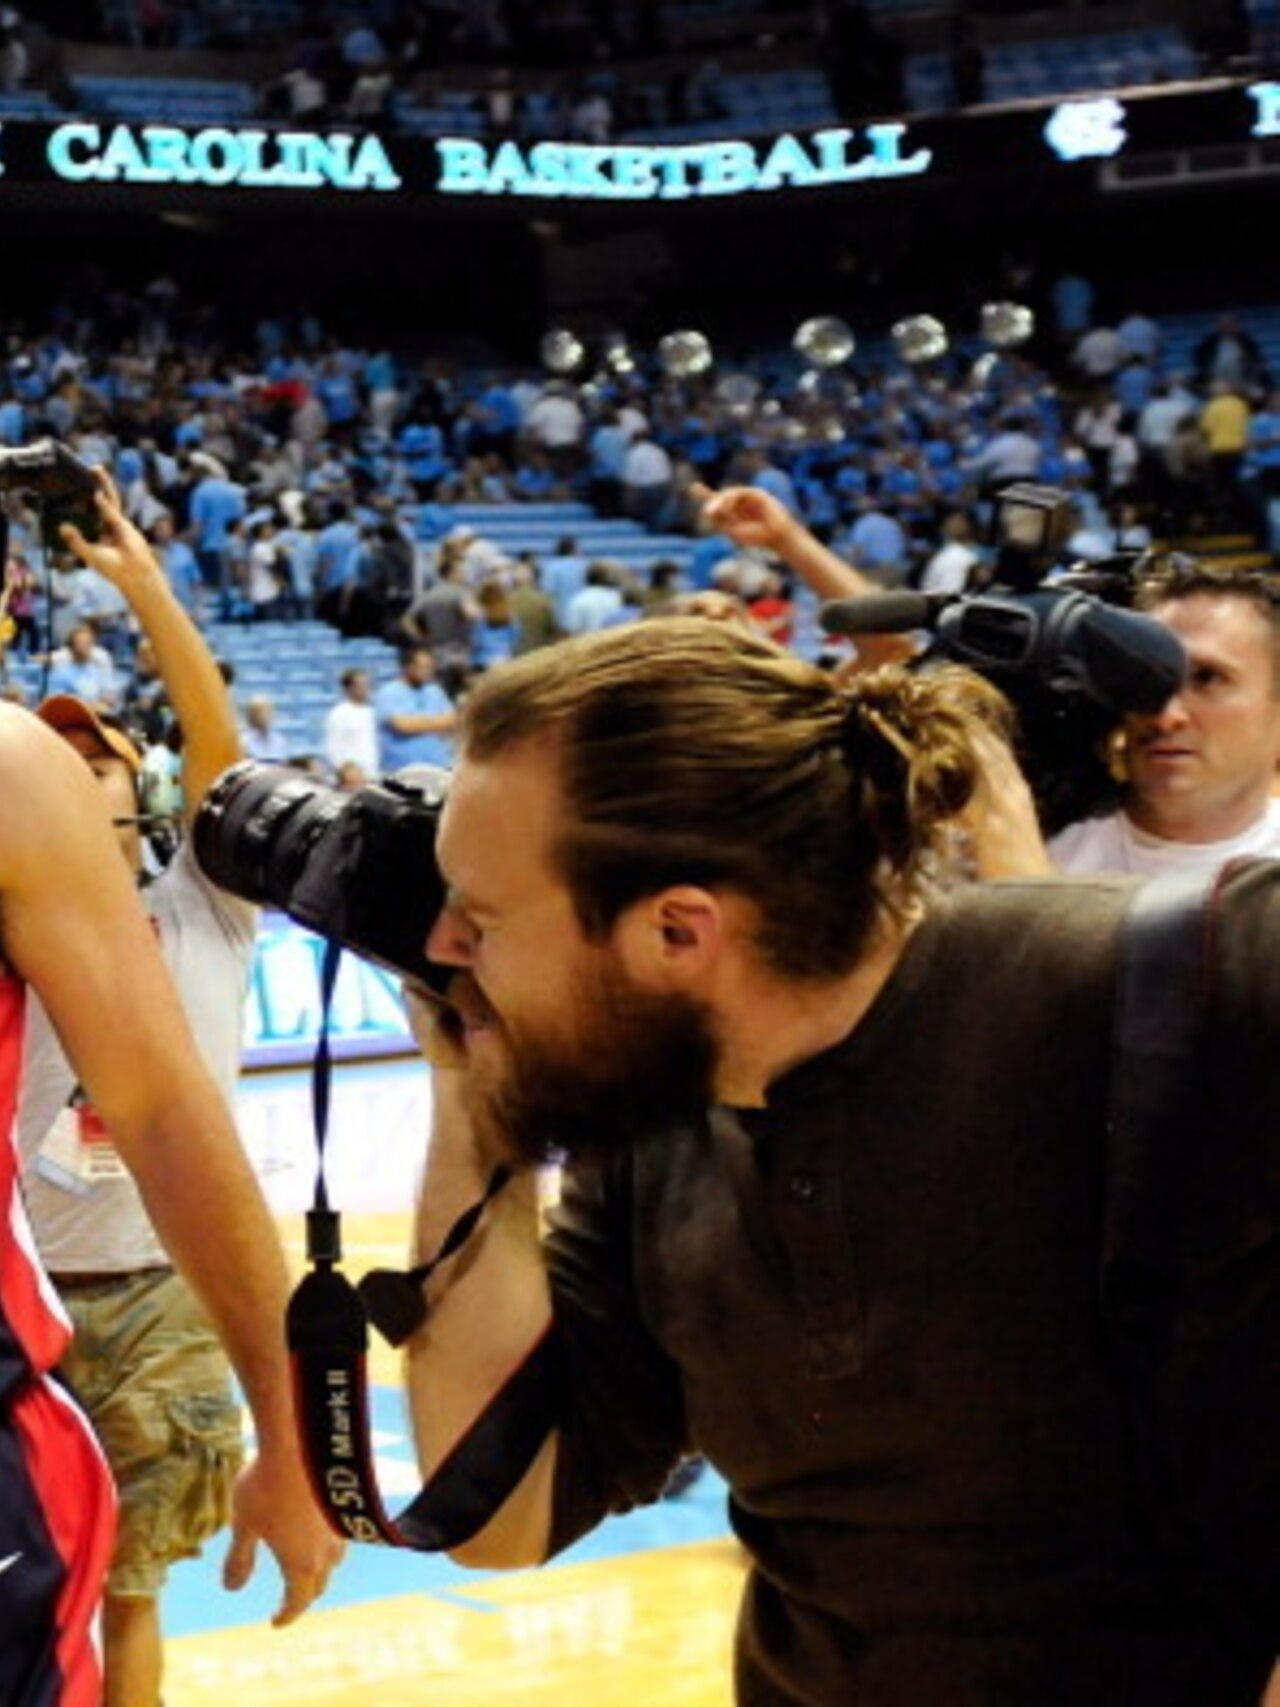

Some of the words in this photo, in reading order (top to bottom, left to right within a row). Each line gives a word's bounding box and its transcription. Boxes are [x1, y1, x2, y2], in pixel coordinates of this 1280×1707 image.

[47, 120, 402, 190] CAROLINA
[435, 122, 932, 199] BASKETBALL
[326, 1388, 355, 1458] Mark
[326, 1465, 365, 1511] 5D
